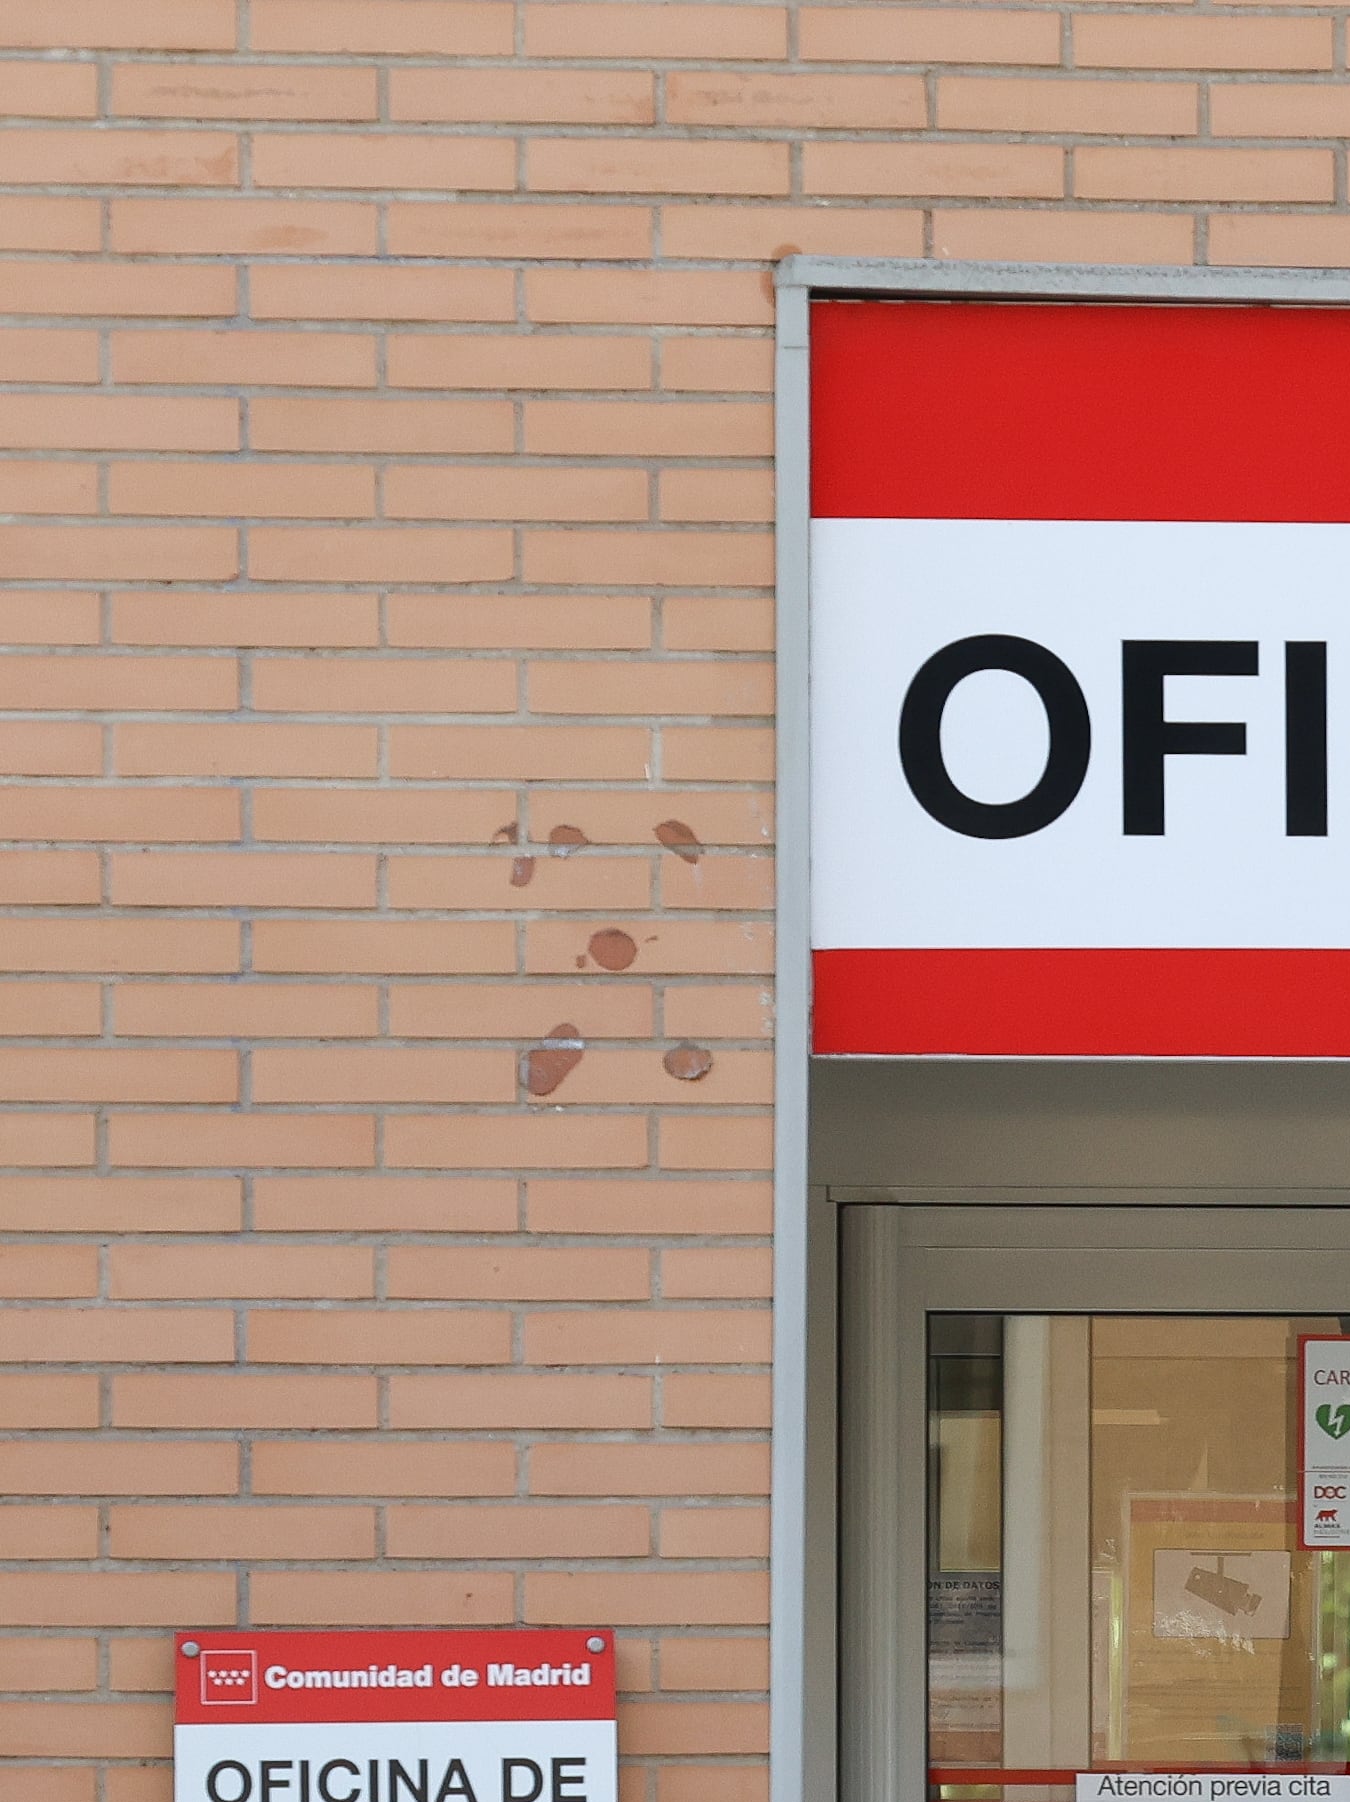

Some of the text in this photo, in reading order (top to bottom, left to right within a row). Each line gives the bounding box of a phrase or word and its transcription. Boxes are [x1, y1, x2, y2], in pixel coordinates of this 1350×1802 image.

[1314, 1486, 1346, 1499] DOC
[264, 1663, 591, 1689] Comunidad de Madrid
[1098, 1775, 1331, 1801] Atención previa cita
